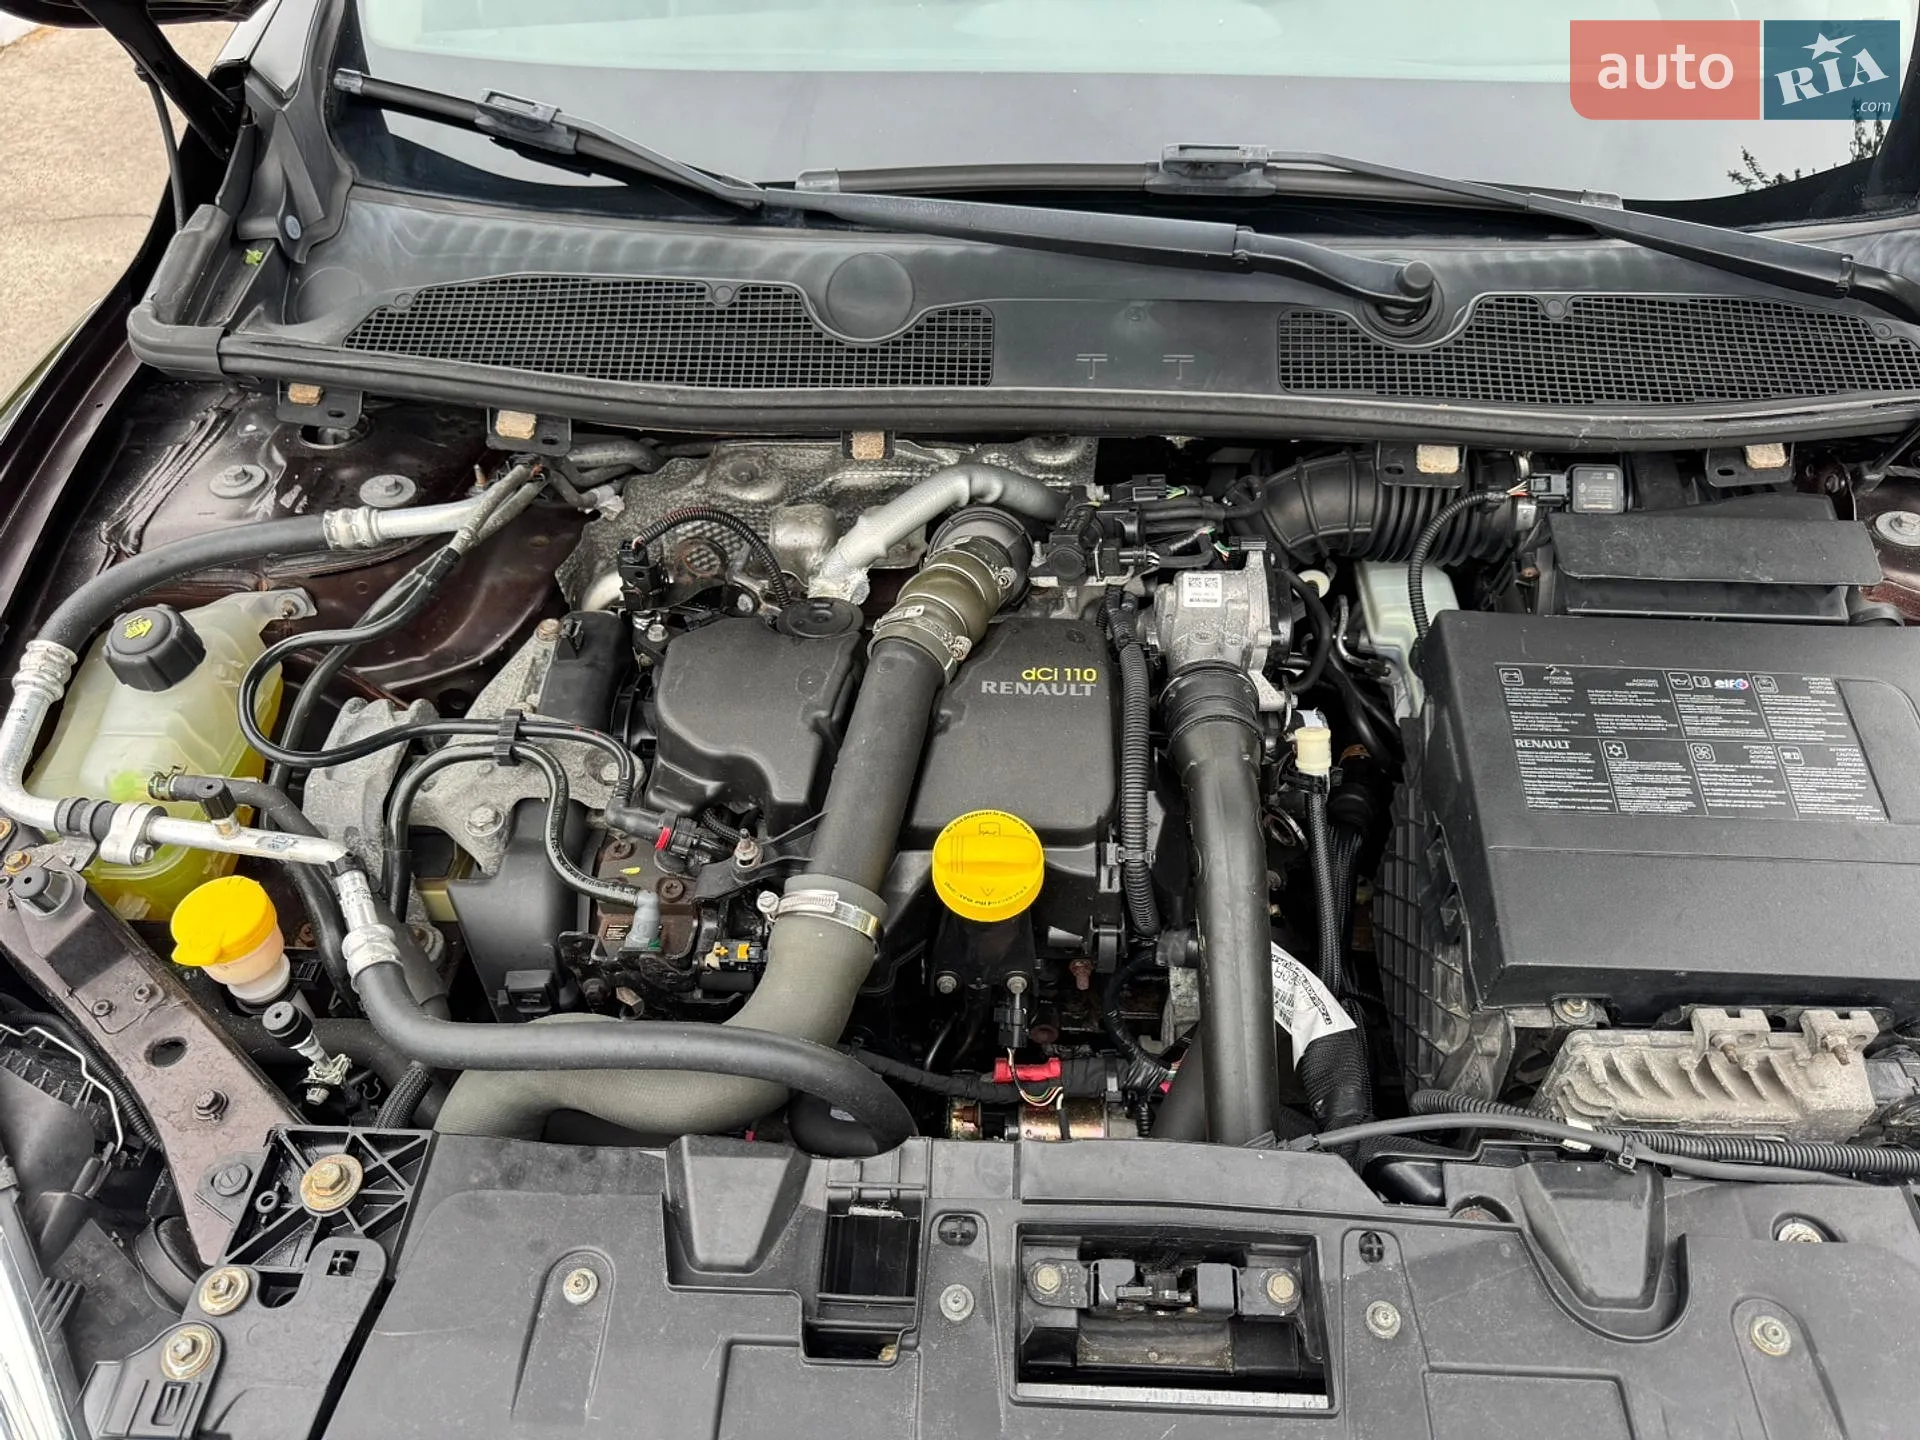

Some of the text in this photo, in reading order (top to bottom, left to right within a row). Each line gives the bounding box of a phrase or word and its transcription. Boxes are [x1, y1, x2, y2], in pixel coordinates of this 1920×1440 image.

[1022, 668, 1097, 681] dCi 110
[981, 680, 1096, 697] RENAULT
[1514, 739, 1571, 750] RENAULT
